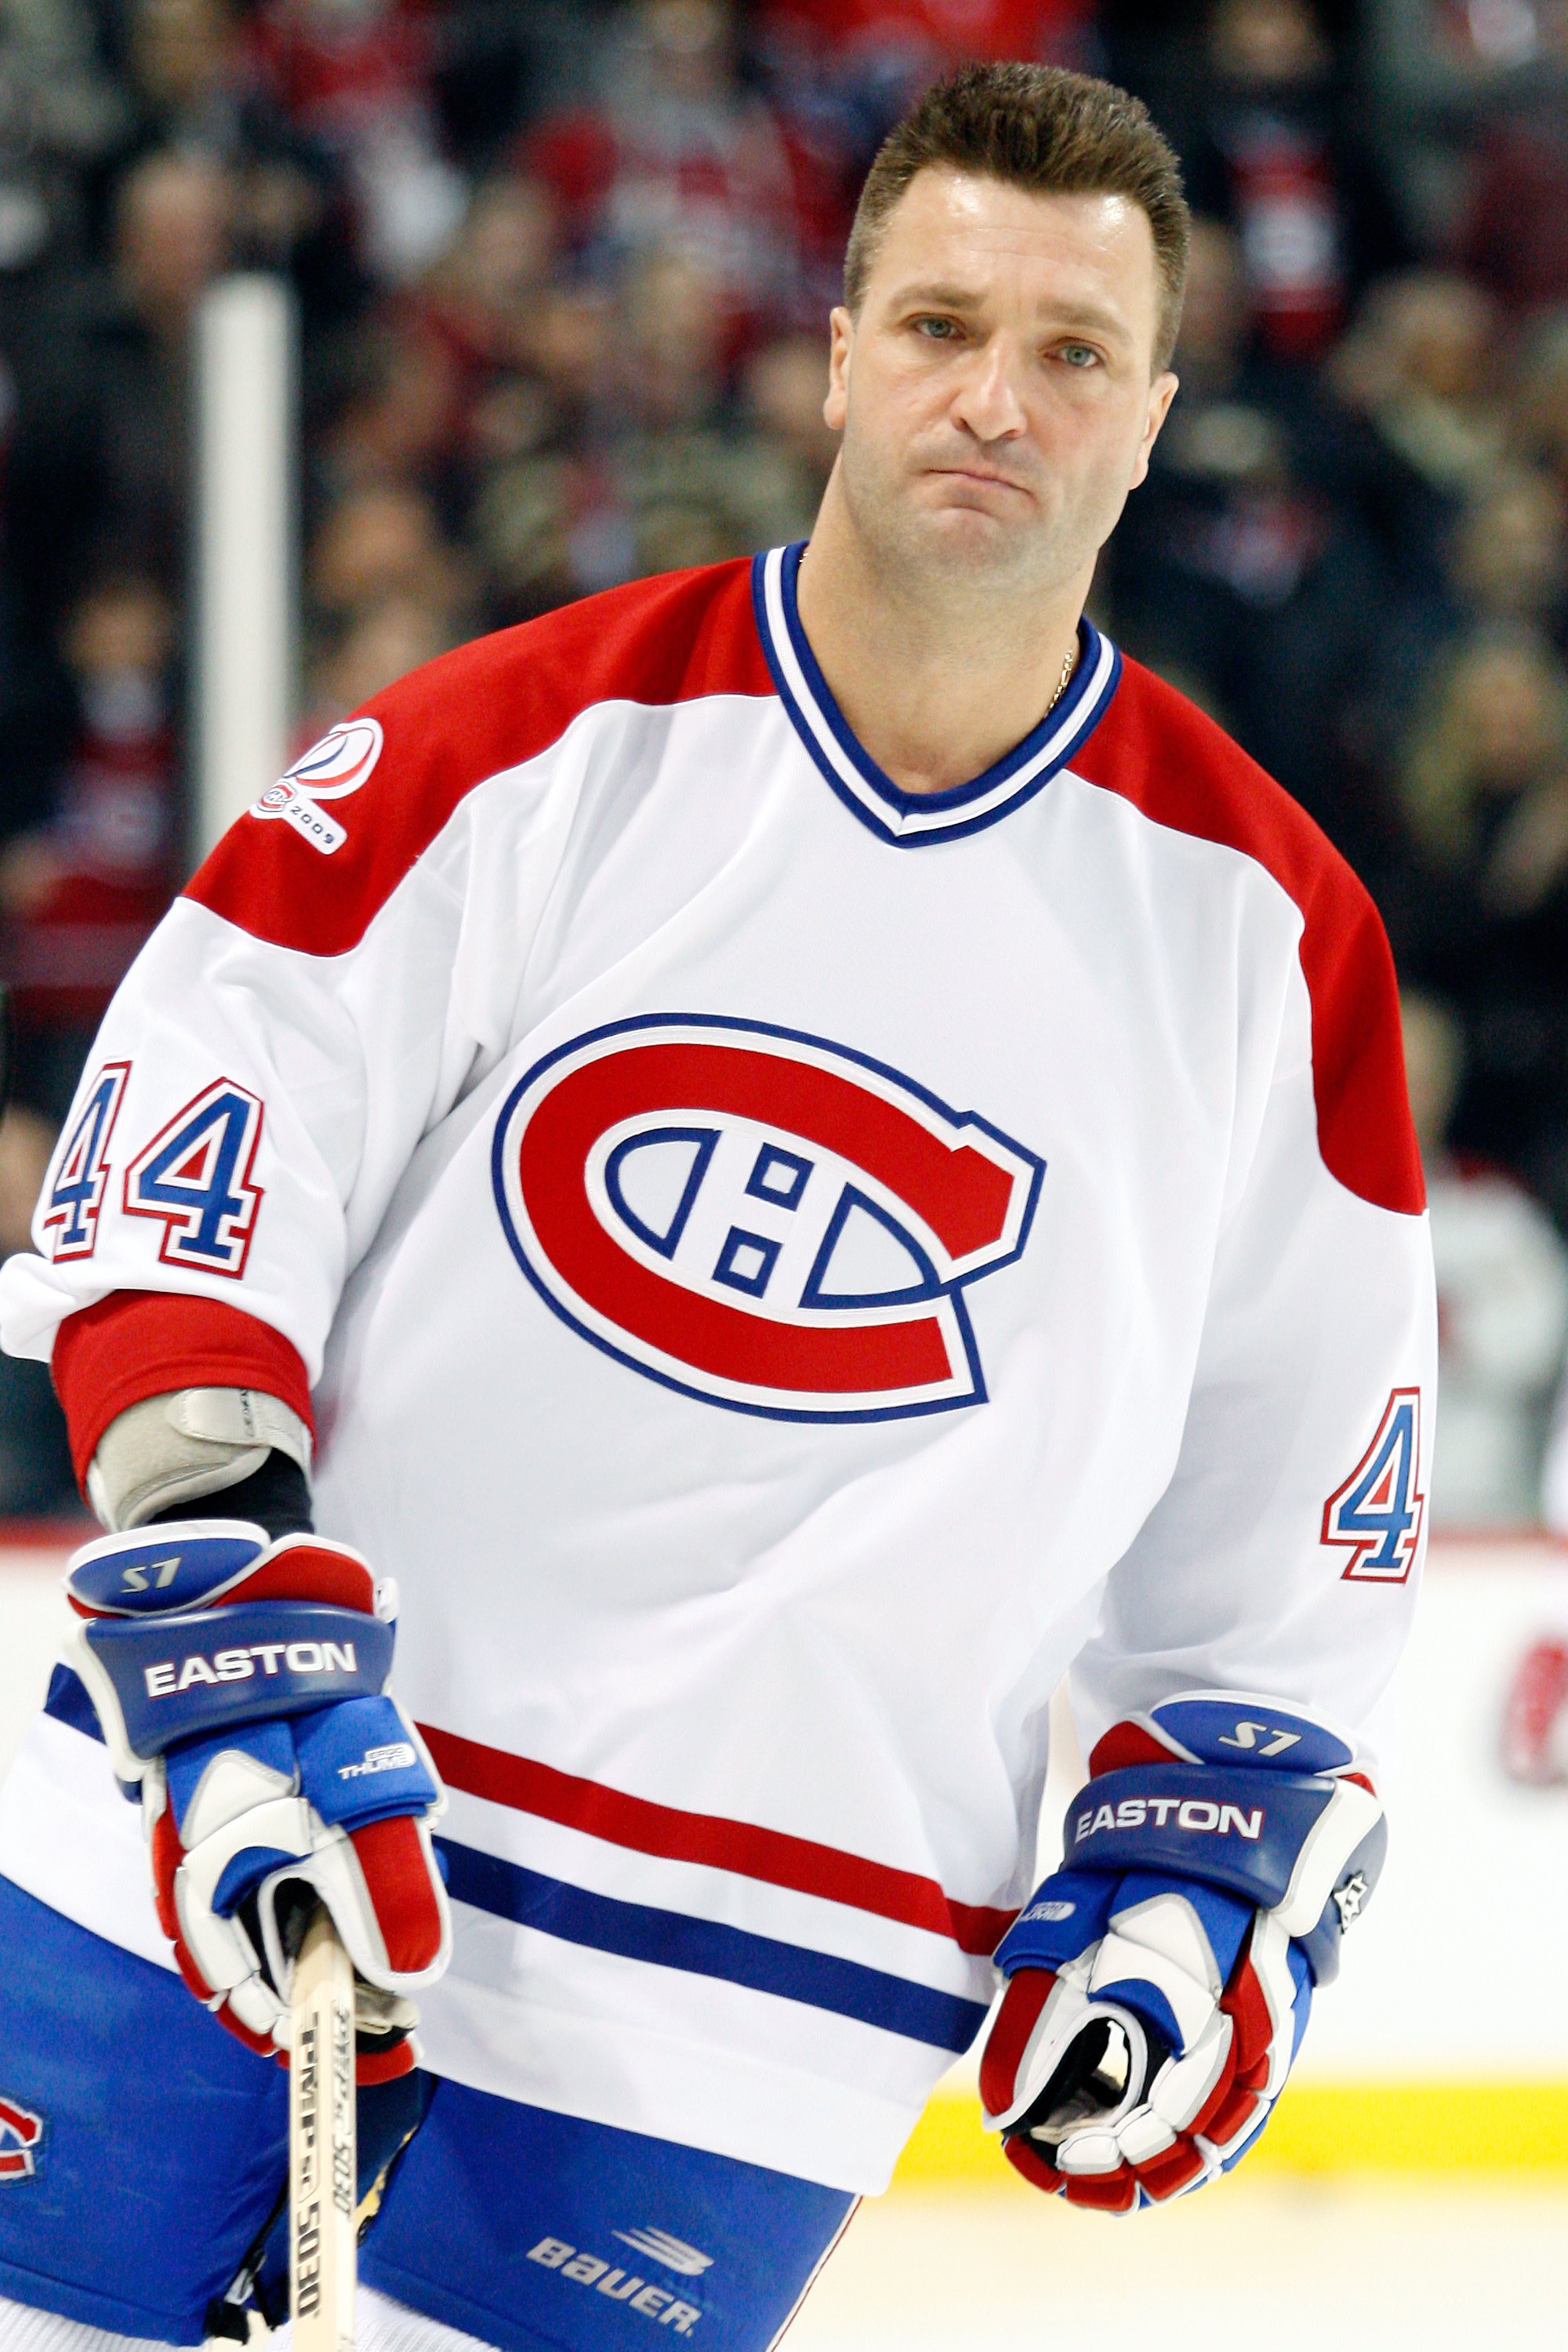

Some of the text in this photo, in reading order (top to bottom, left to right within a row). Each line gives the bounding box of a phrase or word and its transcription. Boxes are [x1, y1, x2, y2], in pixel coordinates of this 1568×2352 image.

[290, 805, 335, 844] 2009
[42, 1059, 267, 1280] 44
[1320, 1386, 1425, 1584] 4
[144, 1642, 358, 1698] EASTON
[1075, 1798, 1264, 1844] EASTON
[297, 2200, 321, 2317] 5030
